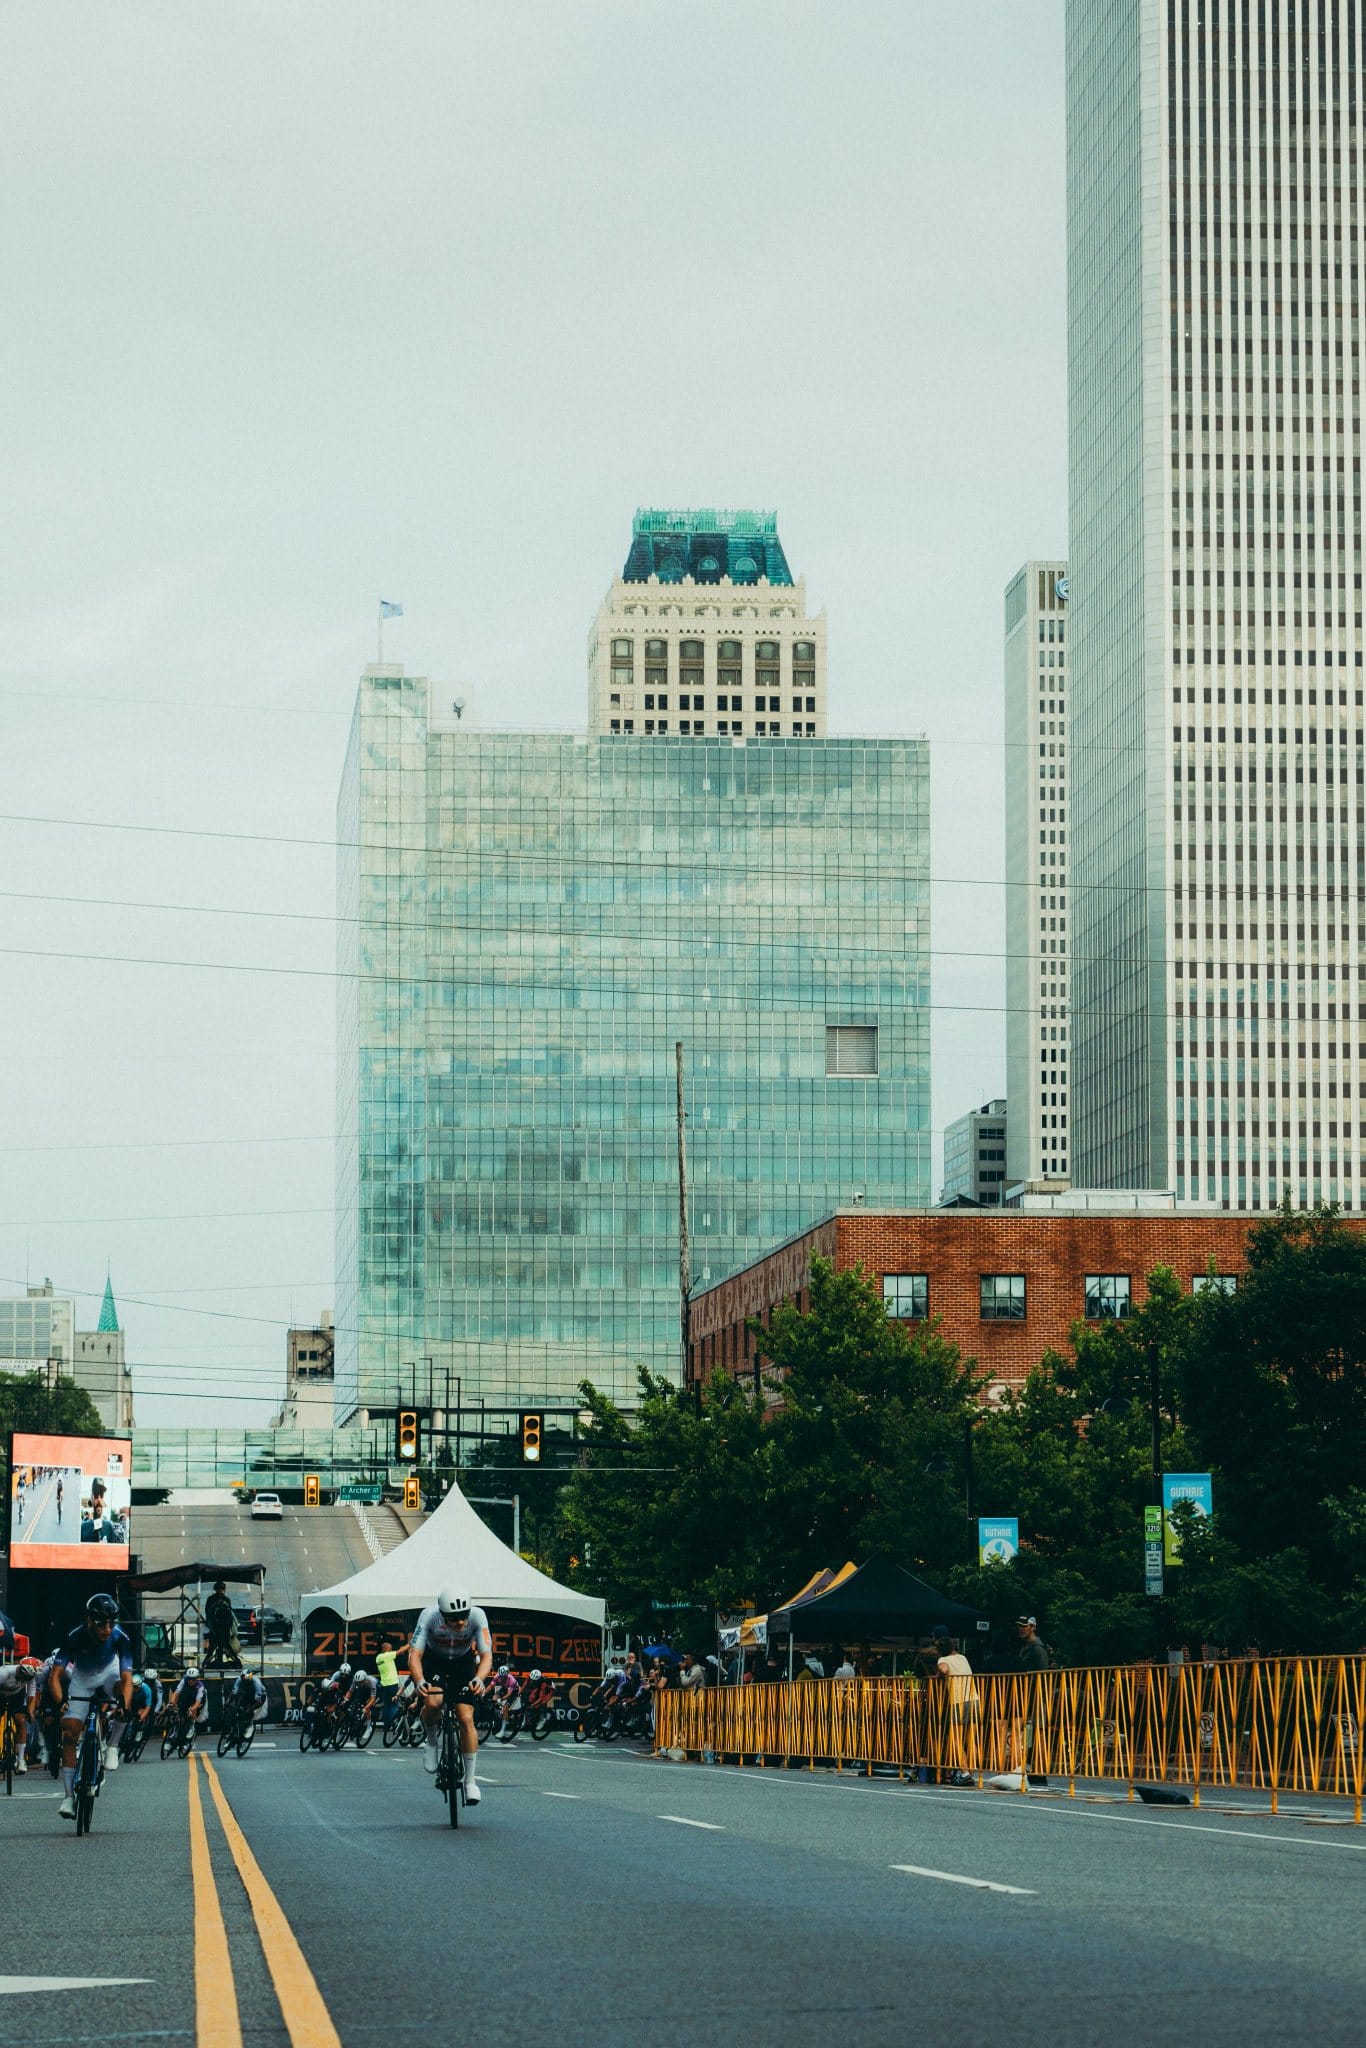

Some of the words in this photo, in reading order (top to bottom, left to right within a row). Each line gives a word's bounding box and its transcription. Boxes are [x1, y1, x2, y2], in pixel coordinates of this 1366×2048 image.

[1170, 1487, 1204, 1497] GUTHRIE
[984, 1528, 1013, 1537] GUTHRIE
[553, 1709, 580, 1721] RO
